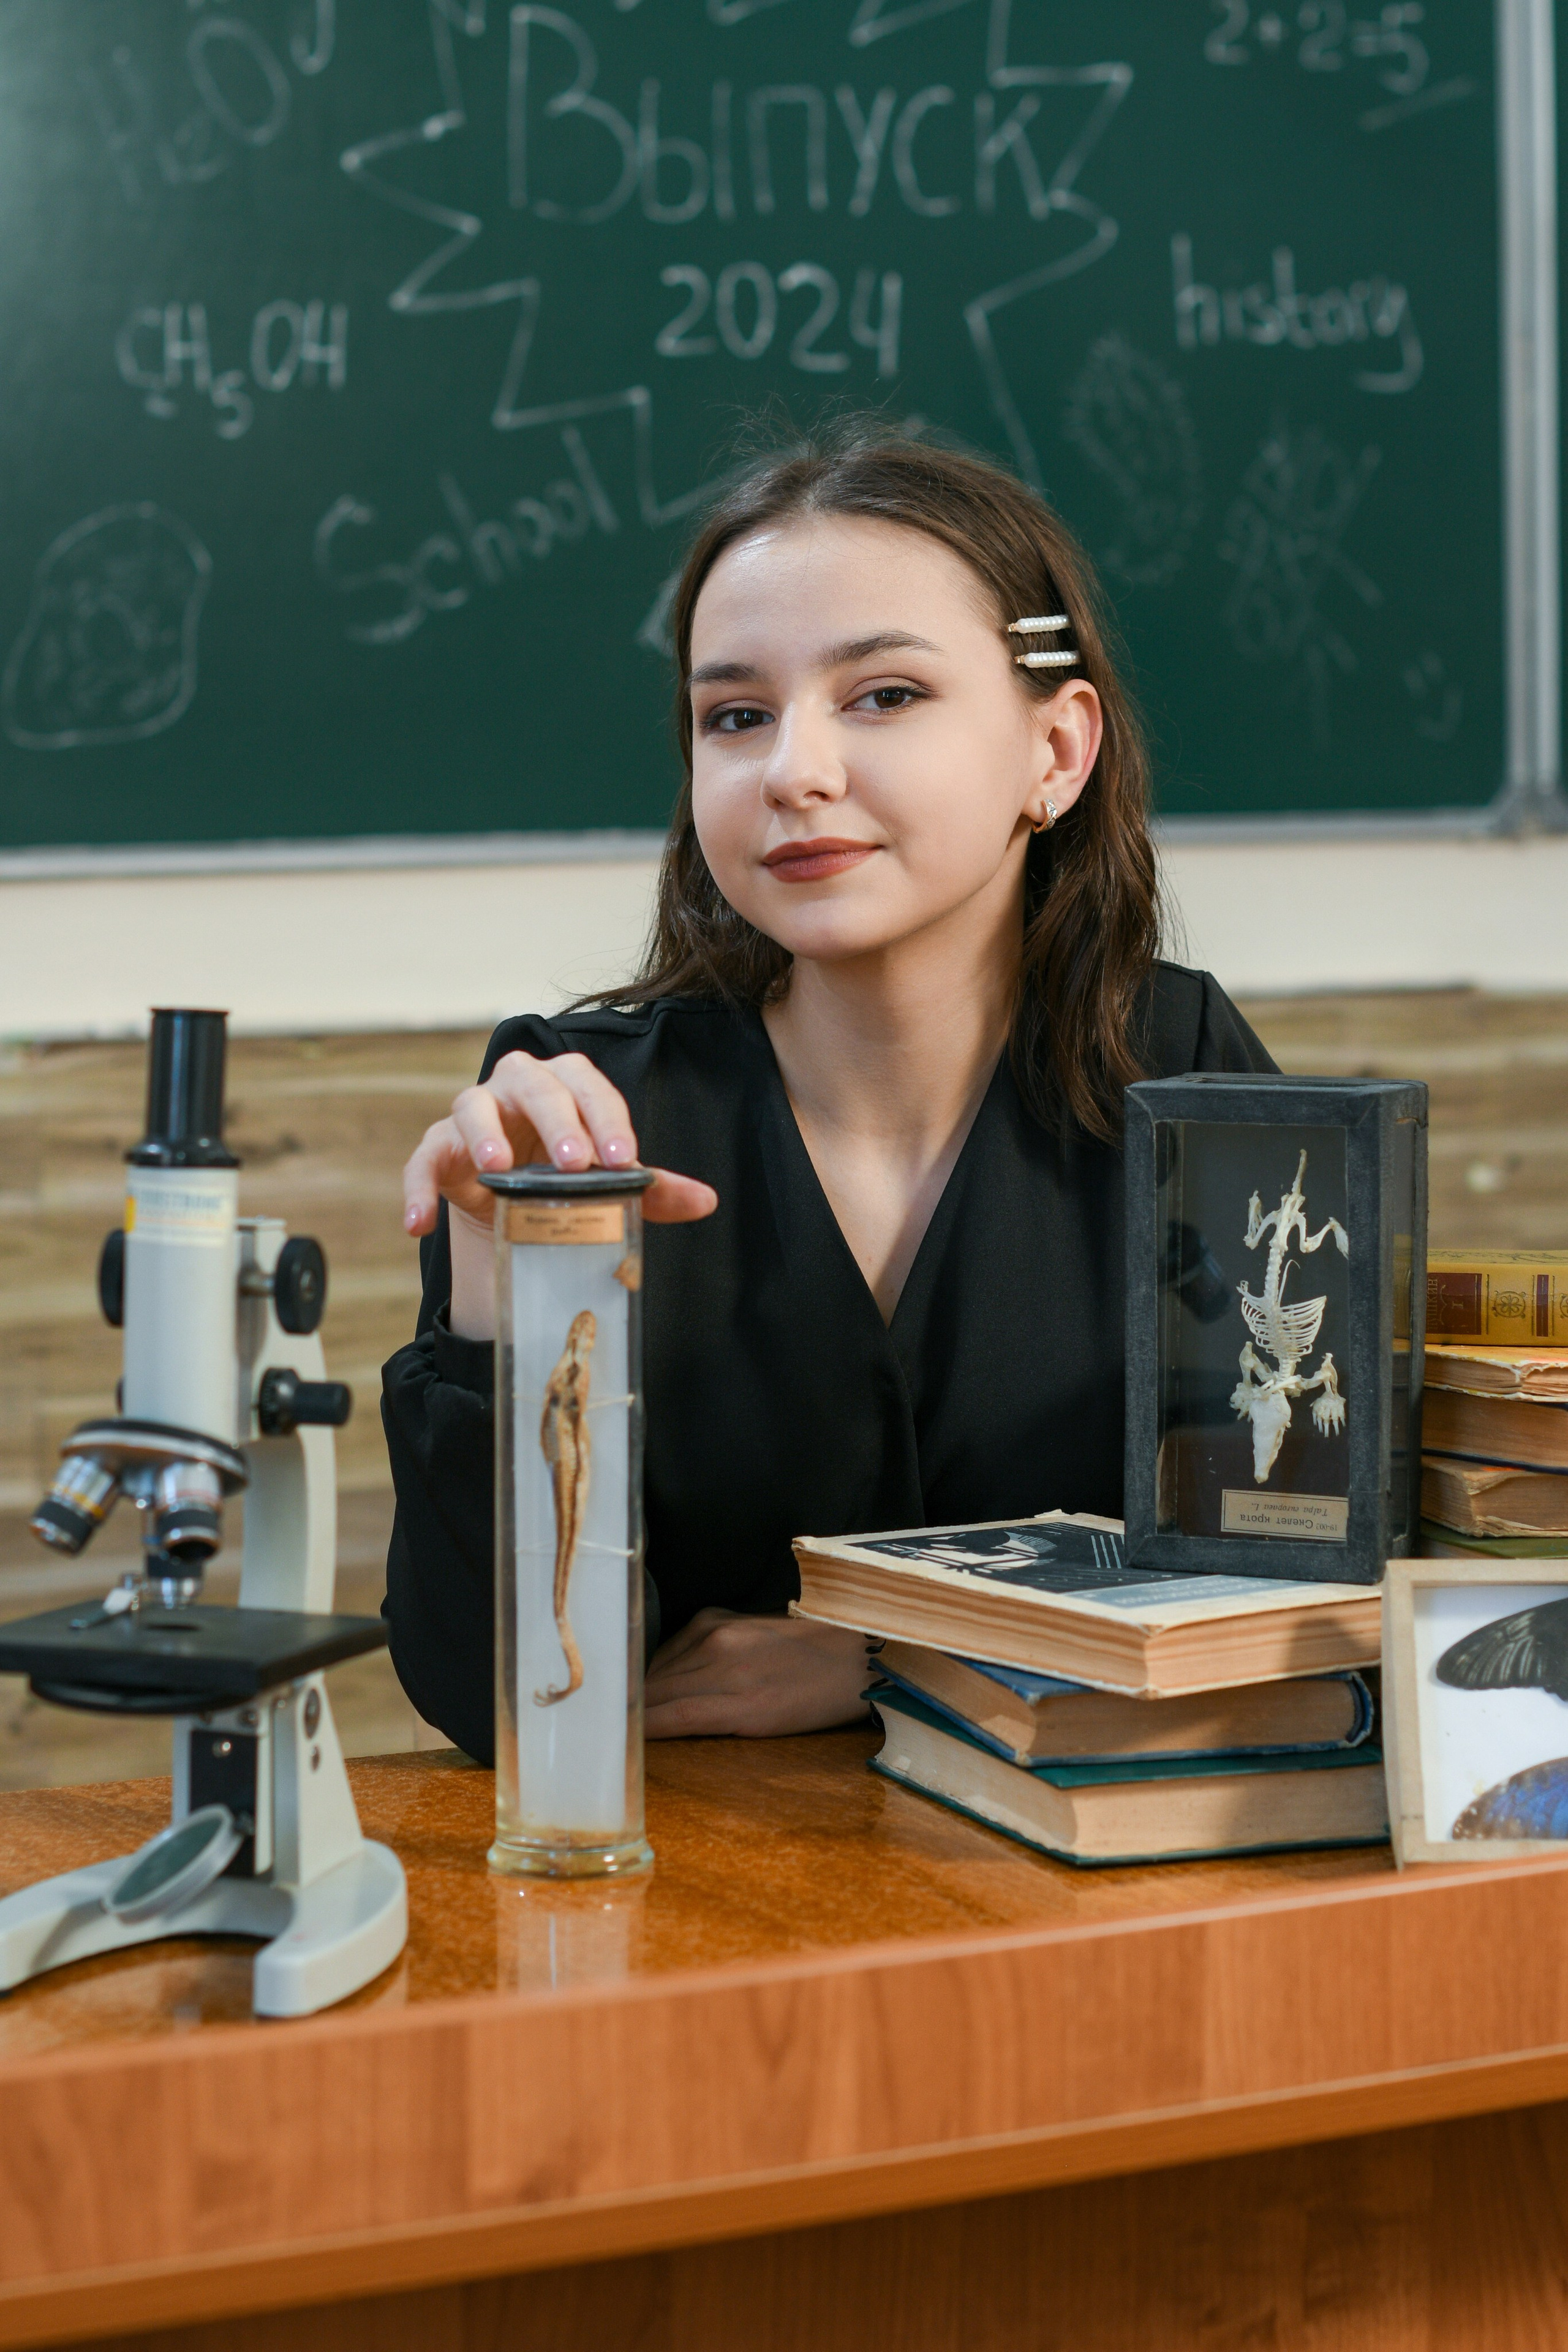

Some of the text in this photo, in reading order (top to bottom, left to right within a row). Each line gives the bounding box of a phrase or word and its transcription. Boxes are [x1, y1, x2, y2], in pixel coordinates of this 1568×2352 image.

[1170, 232, 1425, 394] history
[655, 260, 902, 380] 2024
[1264, 1504, 1299, 1513] europaea
[1303, 1507, 1328, 1517] Talpa
[1240, 1513, 1270, 1525] крота
[1276, 1517, 1313, 1529] Скелет
